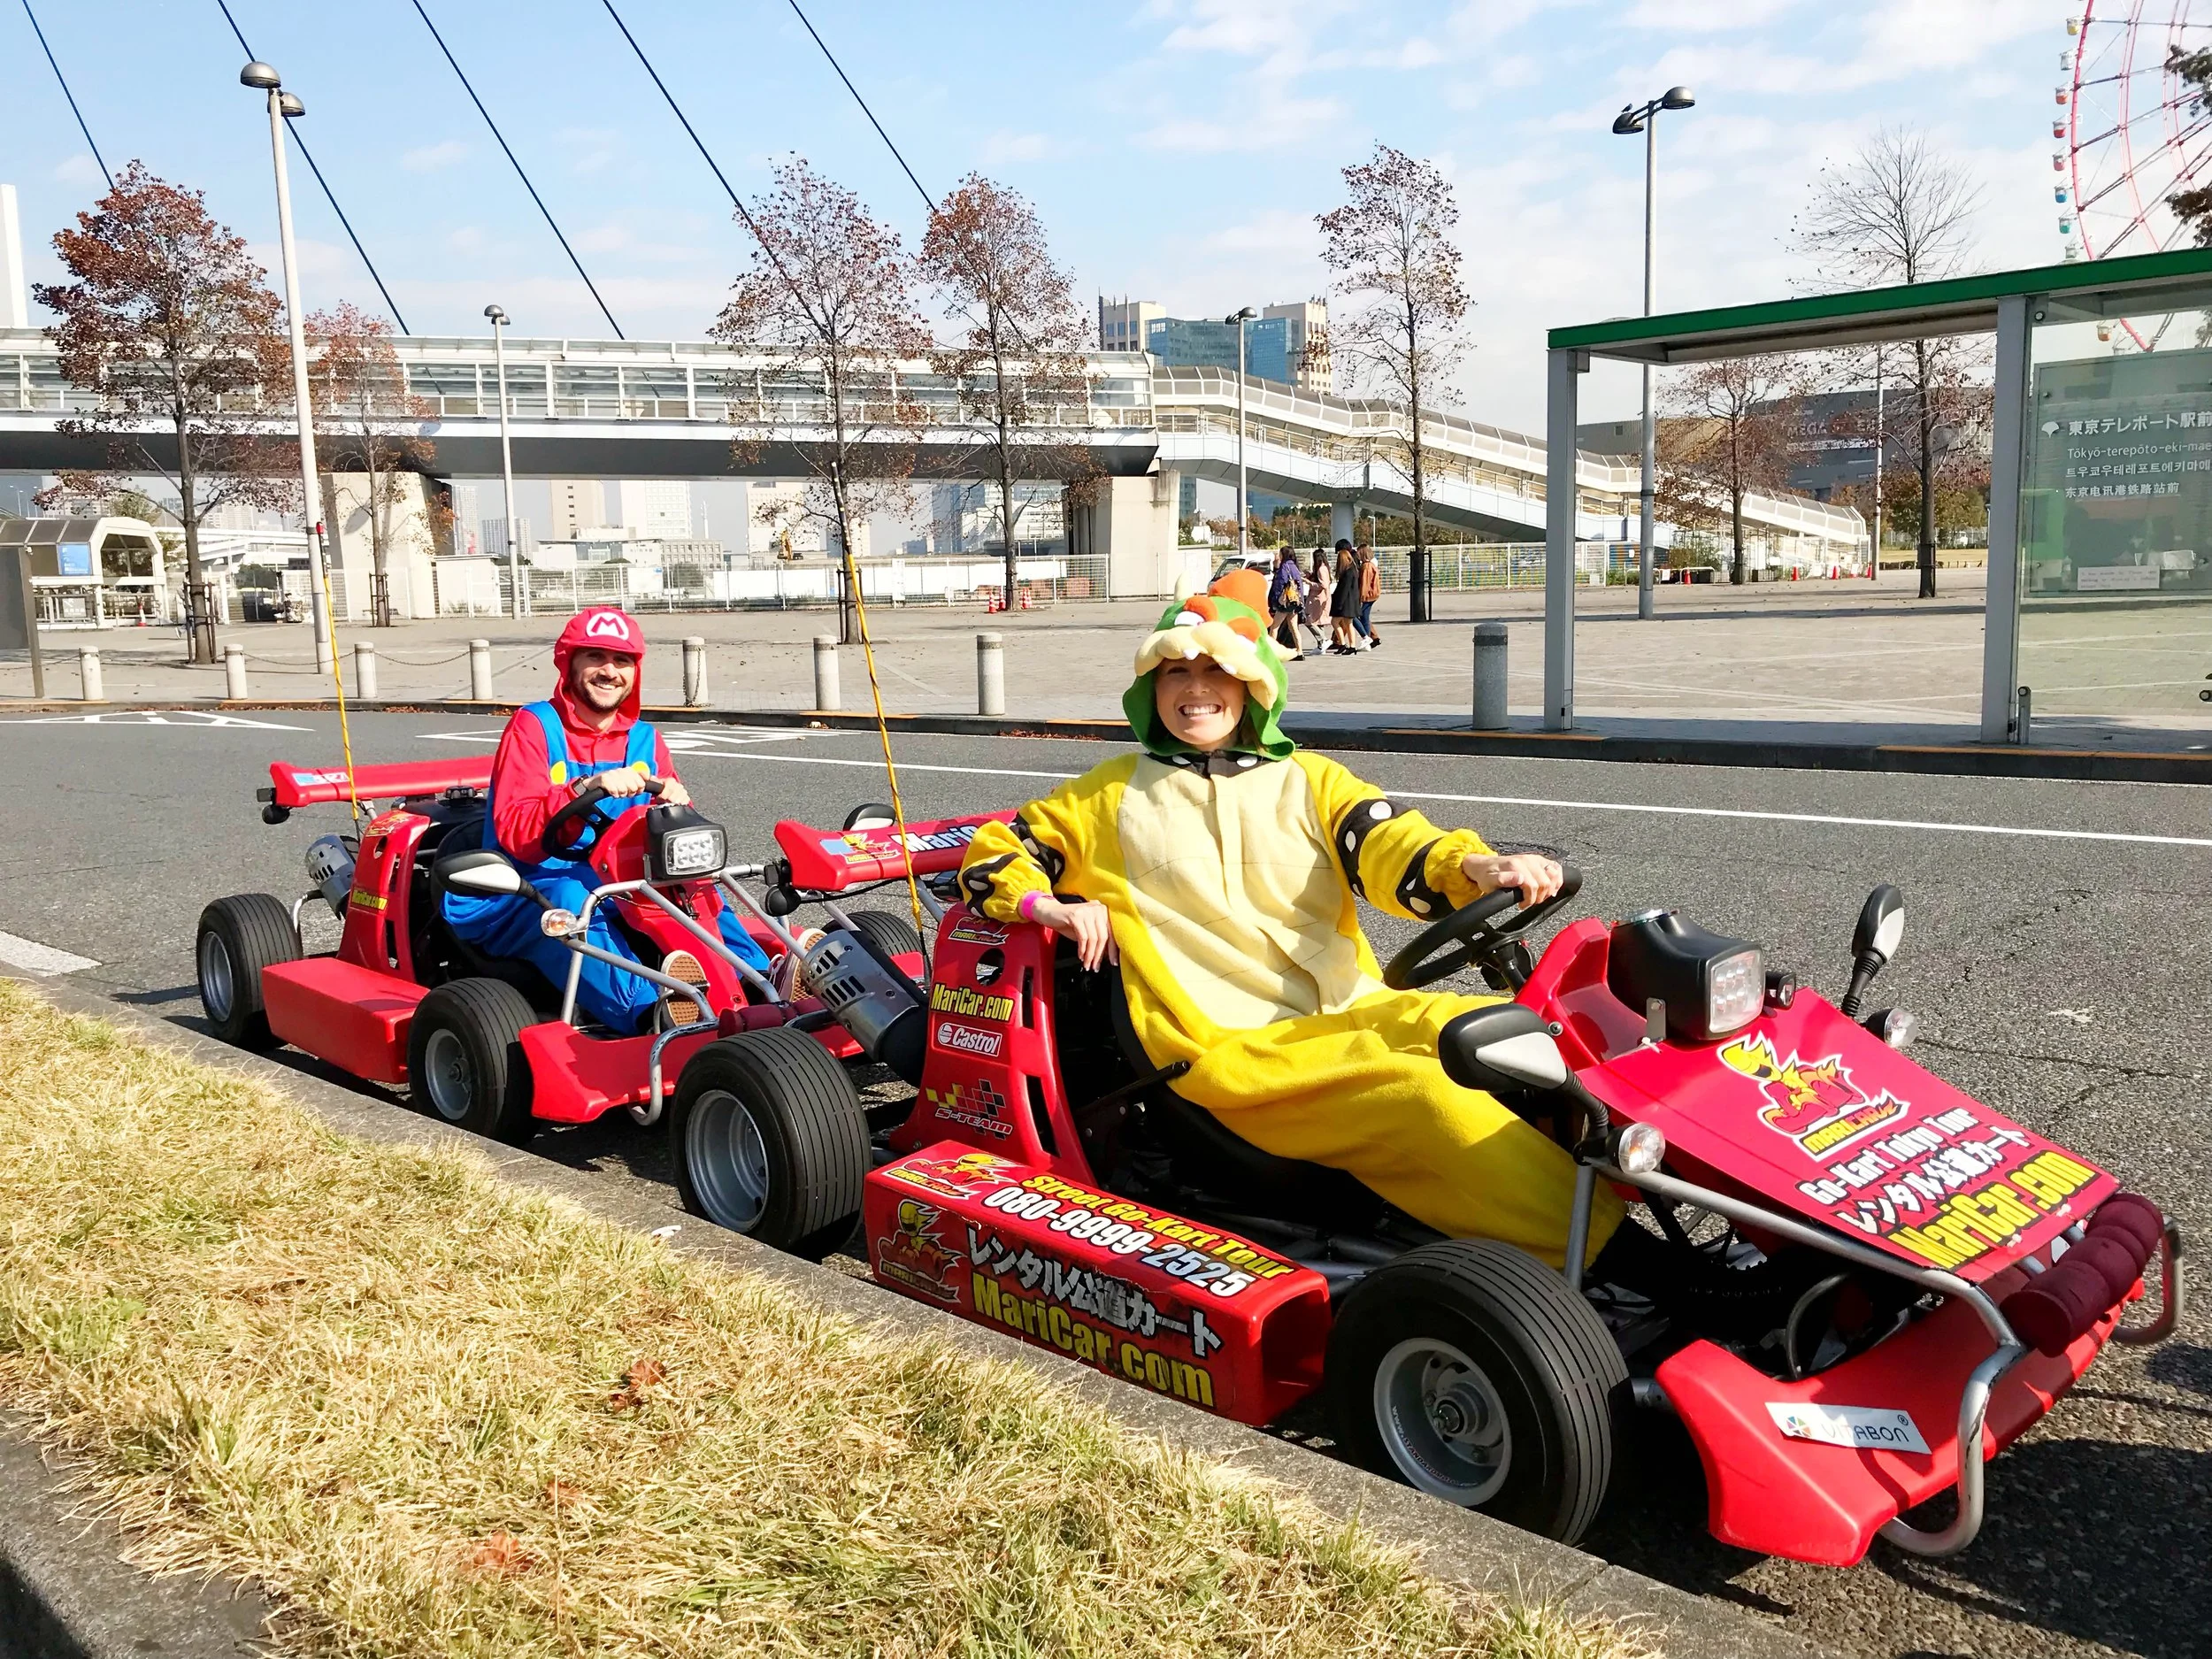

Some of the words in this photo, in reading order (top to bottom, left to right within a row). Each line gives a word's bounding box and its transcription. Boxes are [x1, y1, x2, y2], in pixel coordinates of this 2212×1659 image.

[2069, 411, 2212, 436] 東京テレポート駅前
[591, 616, 625, 636] M
[930, 983, 1014, 1022] MariCar.com
[952, 1027, 1001, 1054] Castrol
[935, 1108, 1013, 1135] S-TEAM
[1796, 1148, 1896, 1205] Go-Kart
[1872, 1125, 1946, 1163] Tokyo
[1921, 1106, 1981, 1138] Tour
[1802, 1100, 1899, 1154] MARICAR
[890, 1168, 962, 1195] MARICAR
[1835, 1125, 2032, 1235] レンタル公道カート
[1886, 1150, 2097, 1270] MariCar.com
[982, 1186, 1256, 1298] 080-9999-2525
[1020, 1174, 1113, 1209] Street
[1101, 1200, 1213, 1248] Go-Kart
[1211, 1238, 1295, 1279] Tour
[968, 1227, 1221, 1356] レンタル公道カート
[972, 1272, 1214, 1408] MariCarcom
